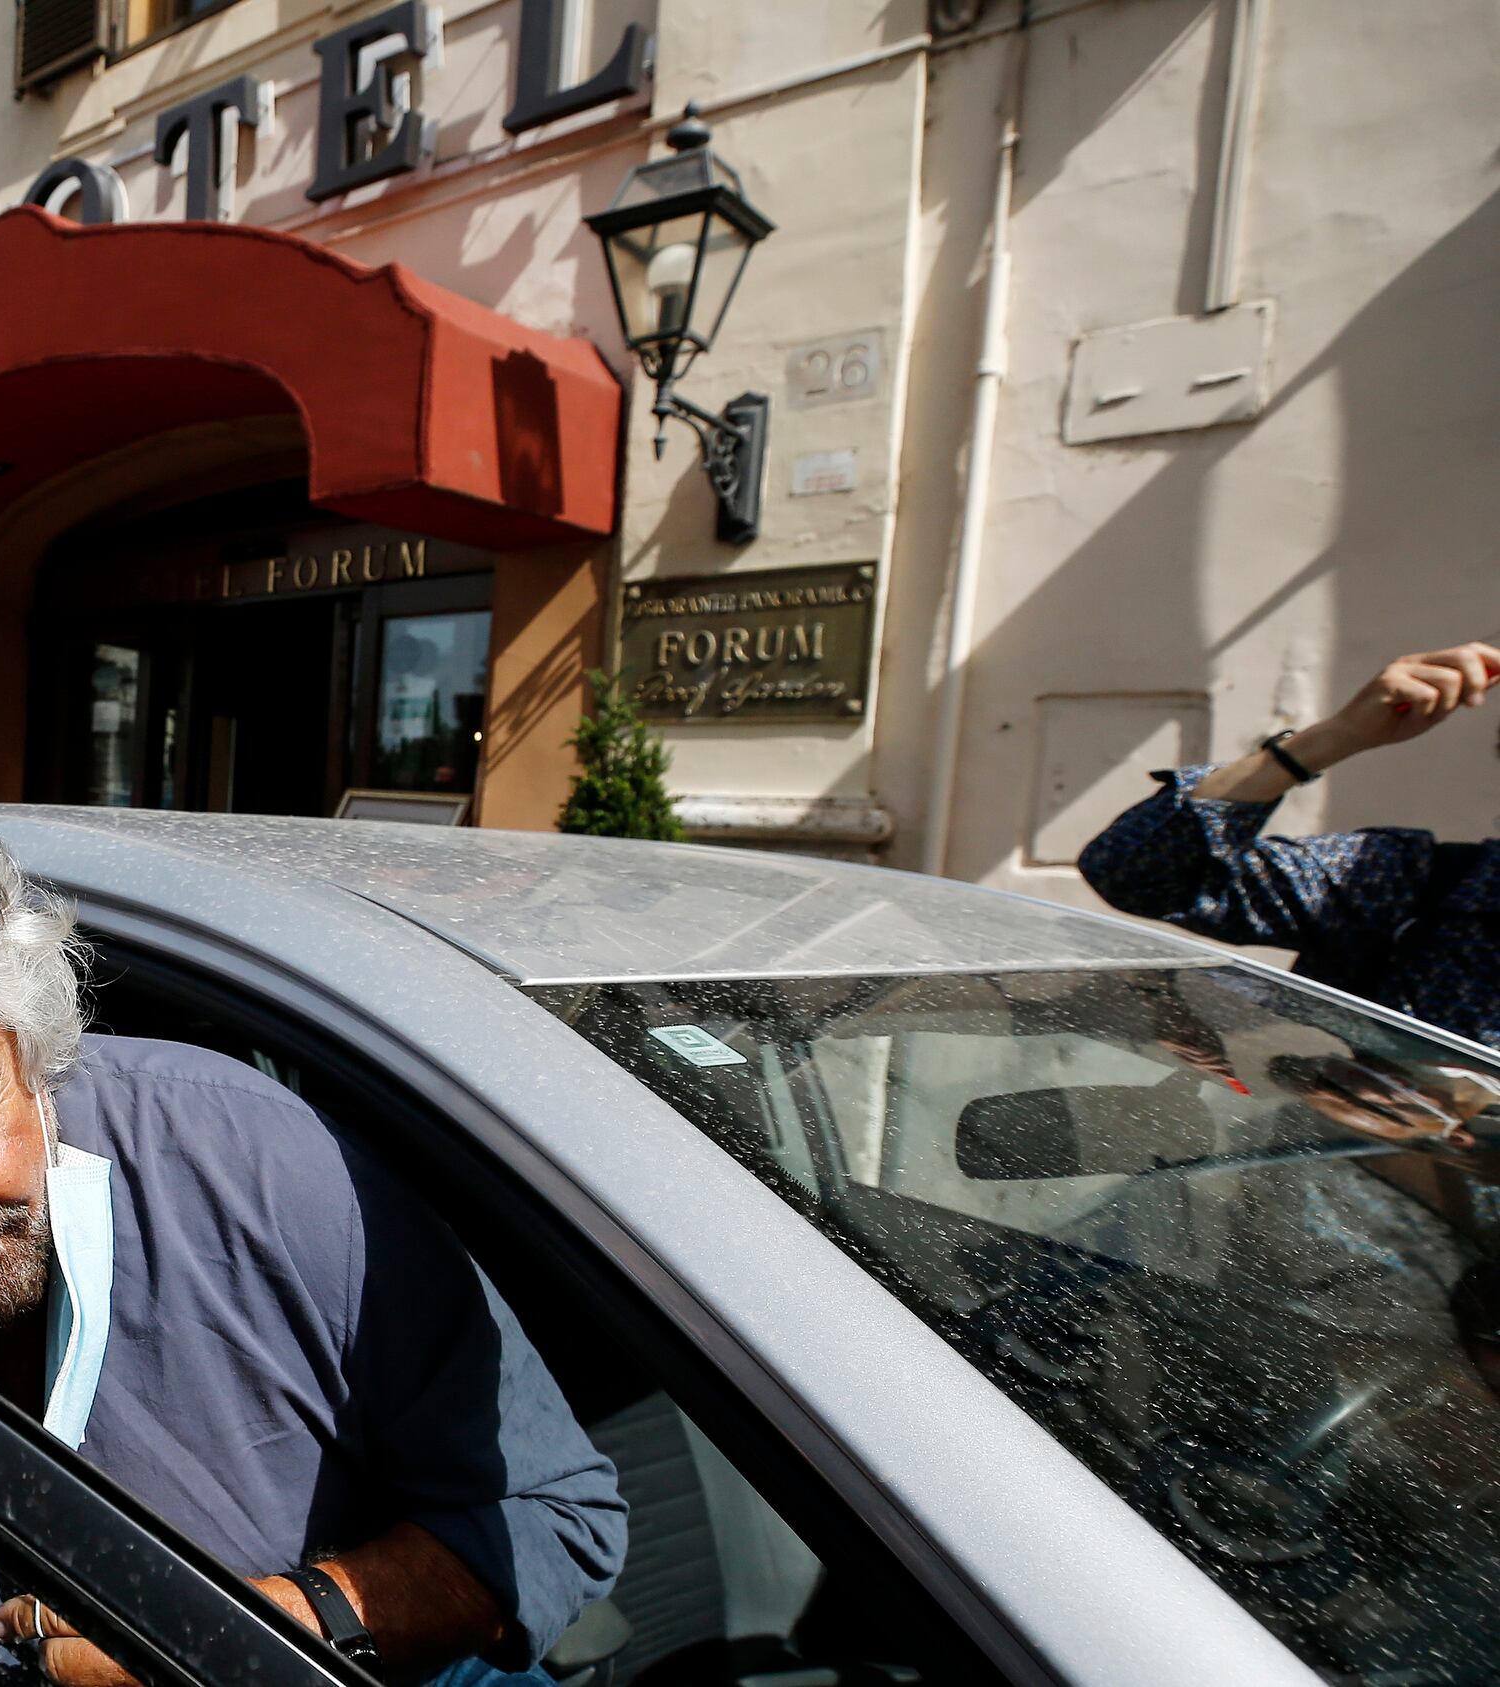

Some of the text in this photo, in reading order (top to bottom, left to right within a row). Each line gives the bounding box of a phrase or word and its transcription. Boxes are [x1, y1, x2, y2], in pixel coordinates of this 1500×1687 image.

[804, 344, 869, 396] 26
[267, 539, 428, 593] FORUM
[658, 621, 825, 667] FORUM
